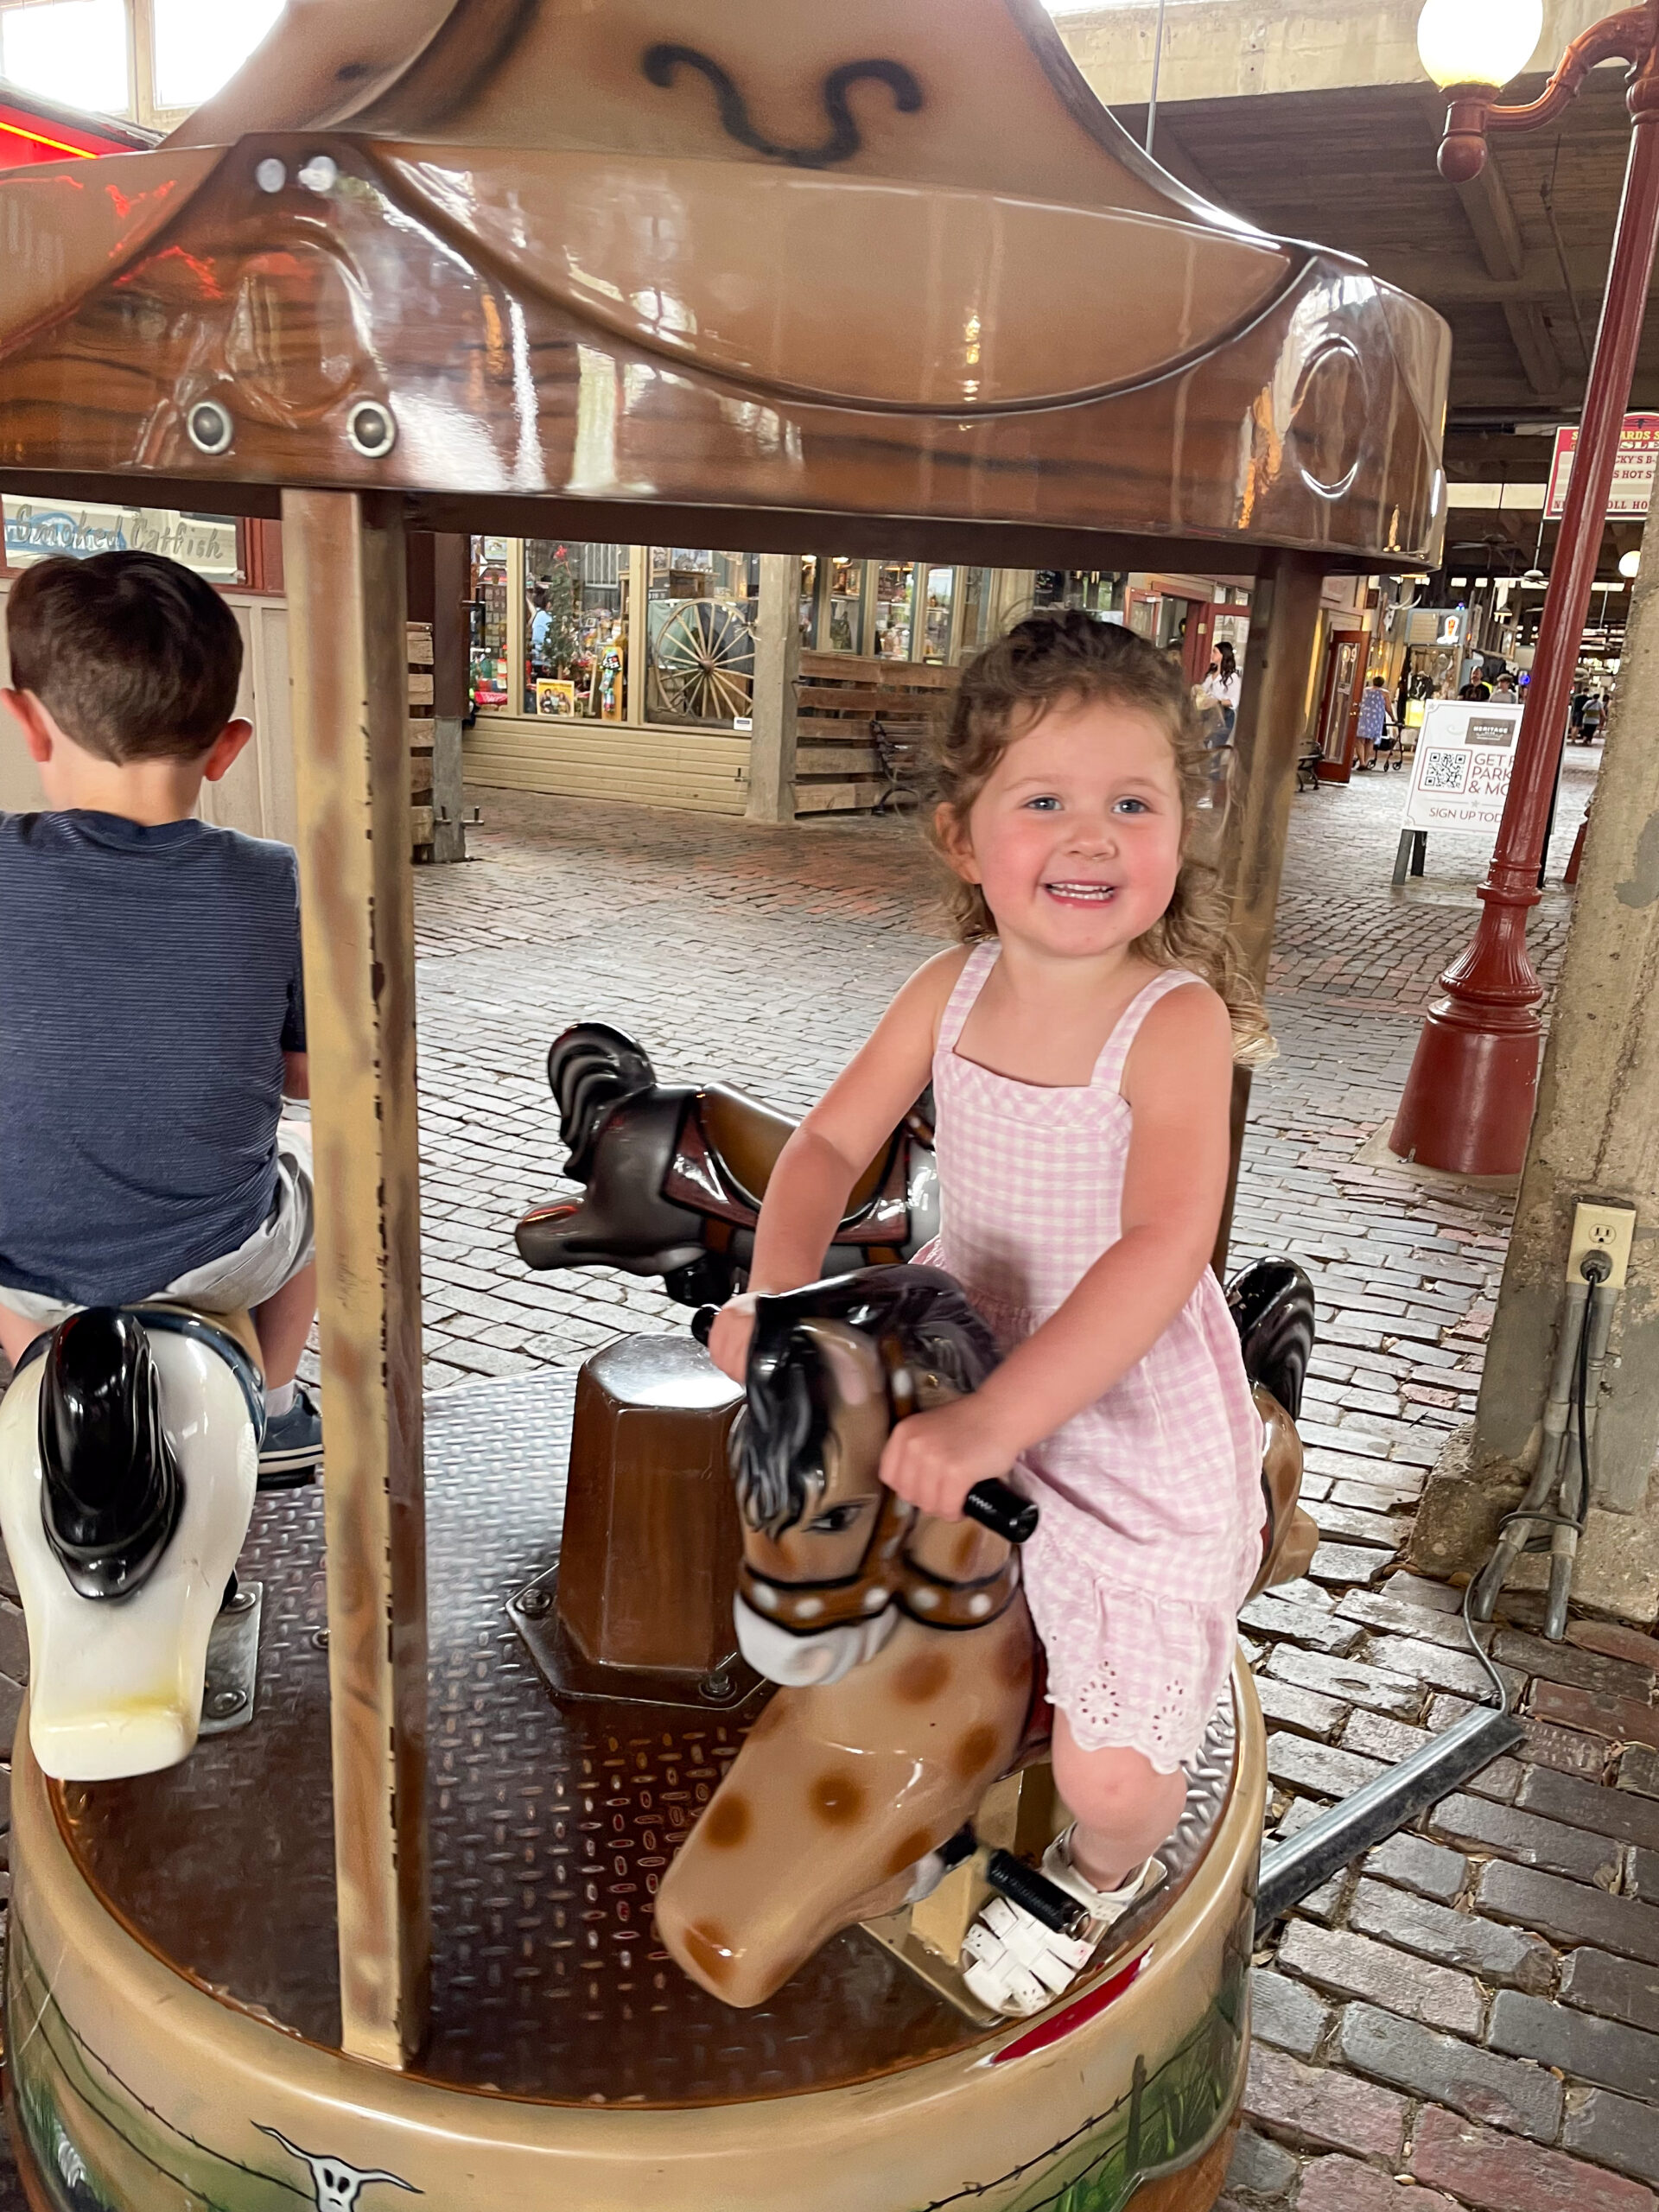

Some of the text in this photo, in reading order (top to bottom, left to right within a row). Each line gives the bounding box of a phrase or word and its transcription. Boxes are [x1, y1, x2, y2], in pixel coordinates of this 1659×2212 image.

[1608, 501, 1627, 510] OLL
[16, 503, 123, 546] Smoked
[130, 517, 223, 560] Catfish
[1474, 753, 1507, 766] GET
[1472, 766, 1512, 780] PARK
[1468, 780, 1510, 795] & MO
[1428, 807, 1502, 823] SIGN UP TOD
